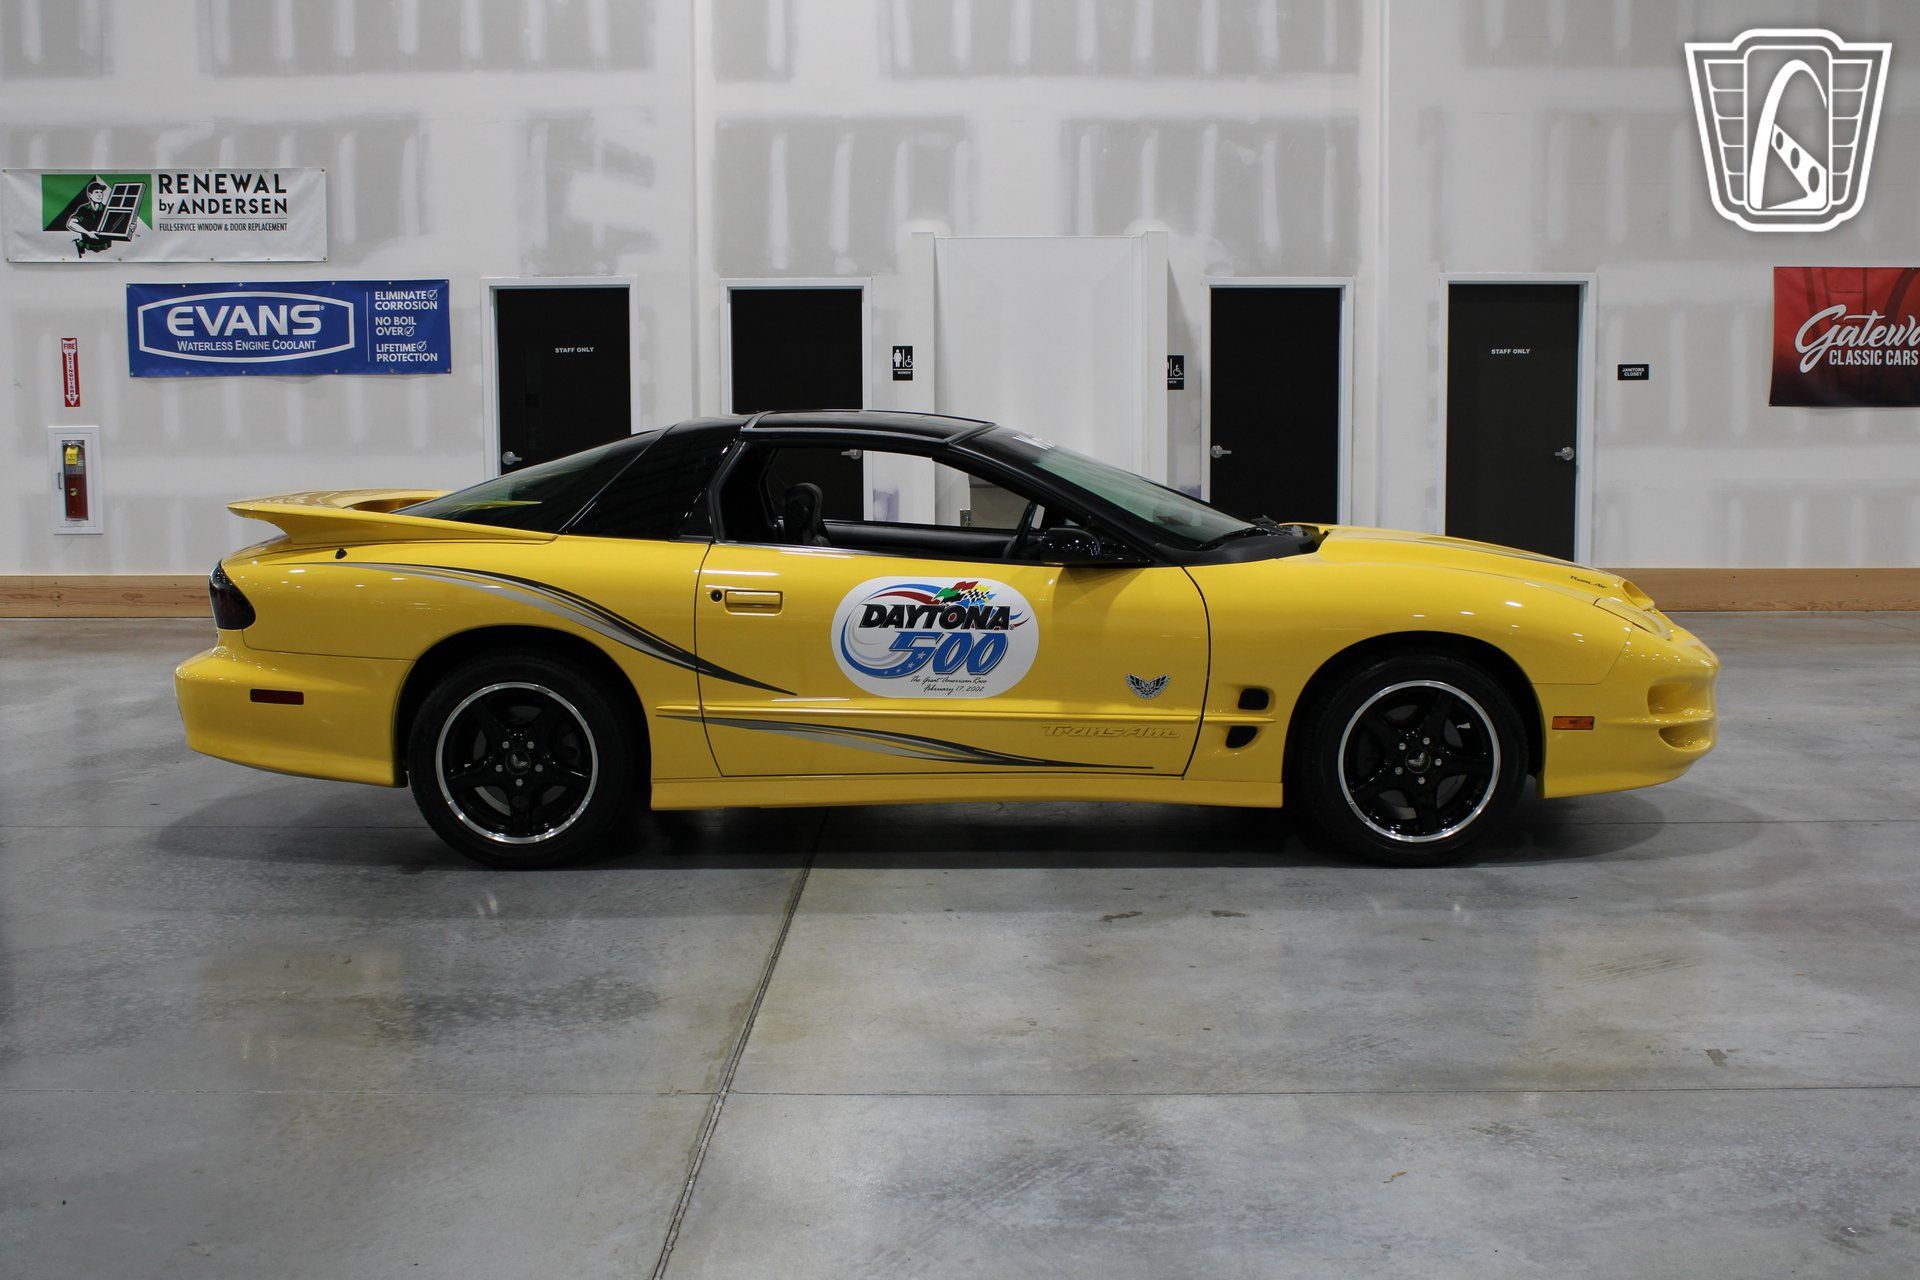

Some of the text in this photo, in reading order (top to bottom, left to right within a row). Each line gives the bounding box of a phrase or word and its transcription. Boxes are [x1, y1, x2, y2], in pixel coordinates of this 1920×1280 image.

[158, 173, 287, 194] RENEWAL
[159, 198, 288, 215] by ANDERSEN
[197, 222, 223, 231] WINDOW
[224, 223, 229, 231] &
[230, 222, 247, 231] DOOR
[247, 222, 288, 231] REPLACEMENT
[375, 290, 427, 300] ELIMINATE
[375, 301, 438, 311] CORROSION
[375, 316, 417, 326] NO BOIL
[376, 326, 404, 336] OVER
[177, 339, 316, 351] WATERLESS ENGINE COOLANT
[376, 343, 416, 353] LIFETIME
[376, 353, 438, 363] PROTECTION
[1829, 350, 1919, 366] CLASSIC CARS
[859, 603, 1011, 630] DAYTONA
[888, 631, 1009, 678] 500
[924, 684, 954, 695] February
